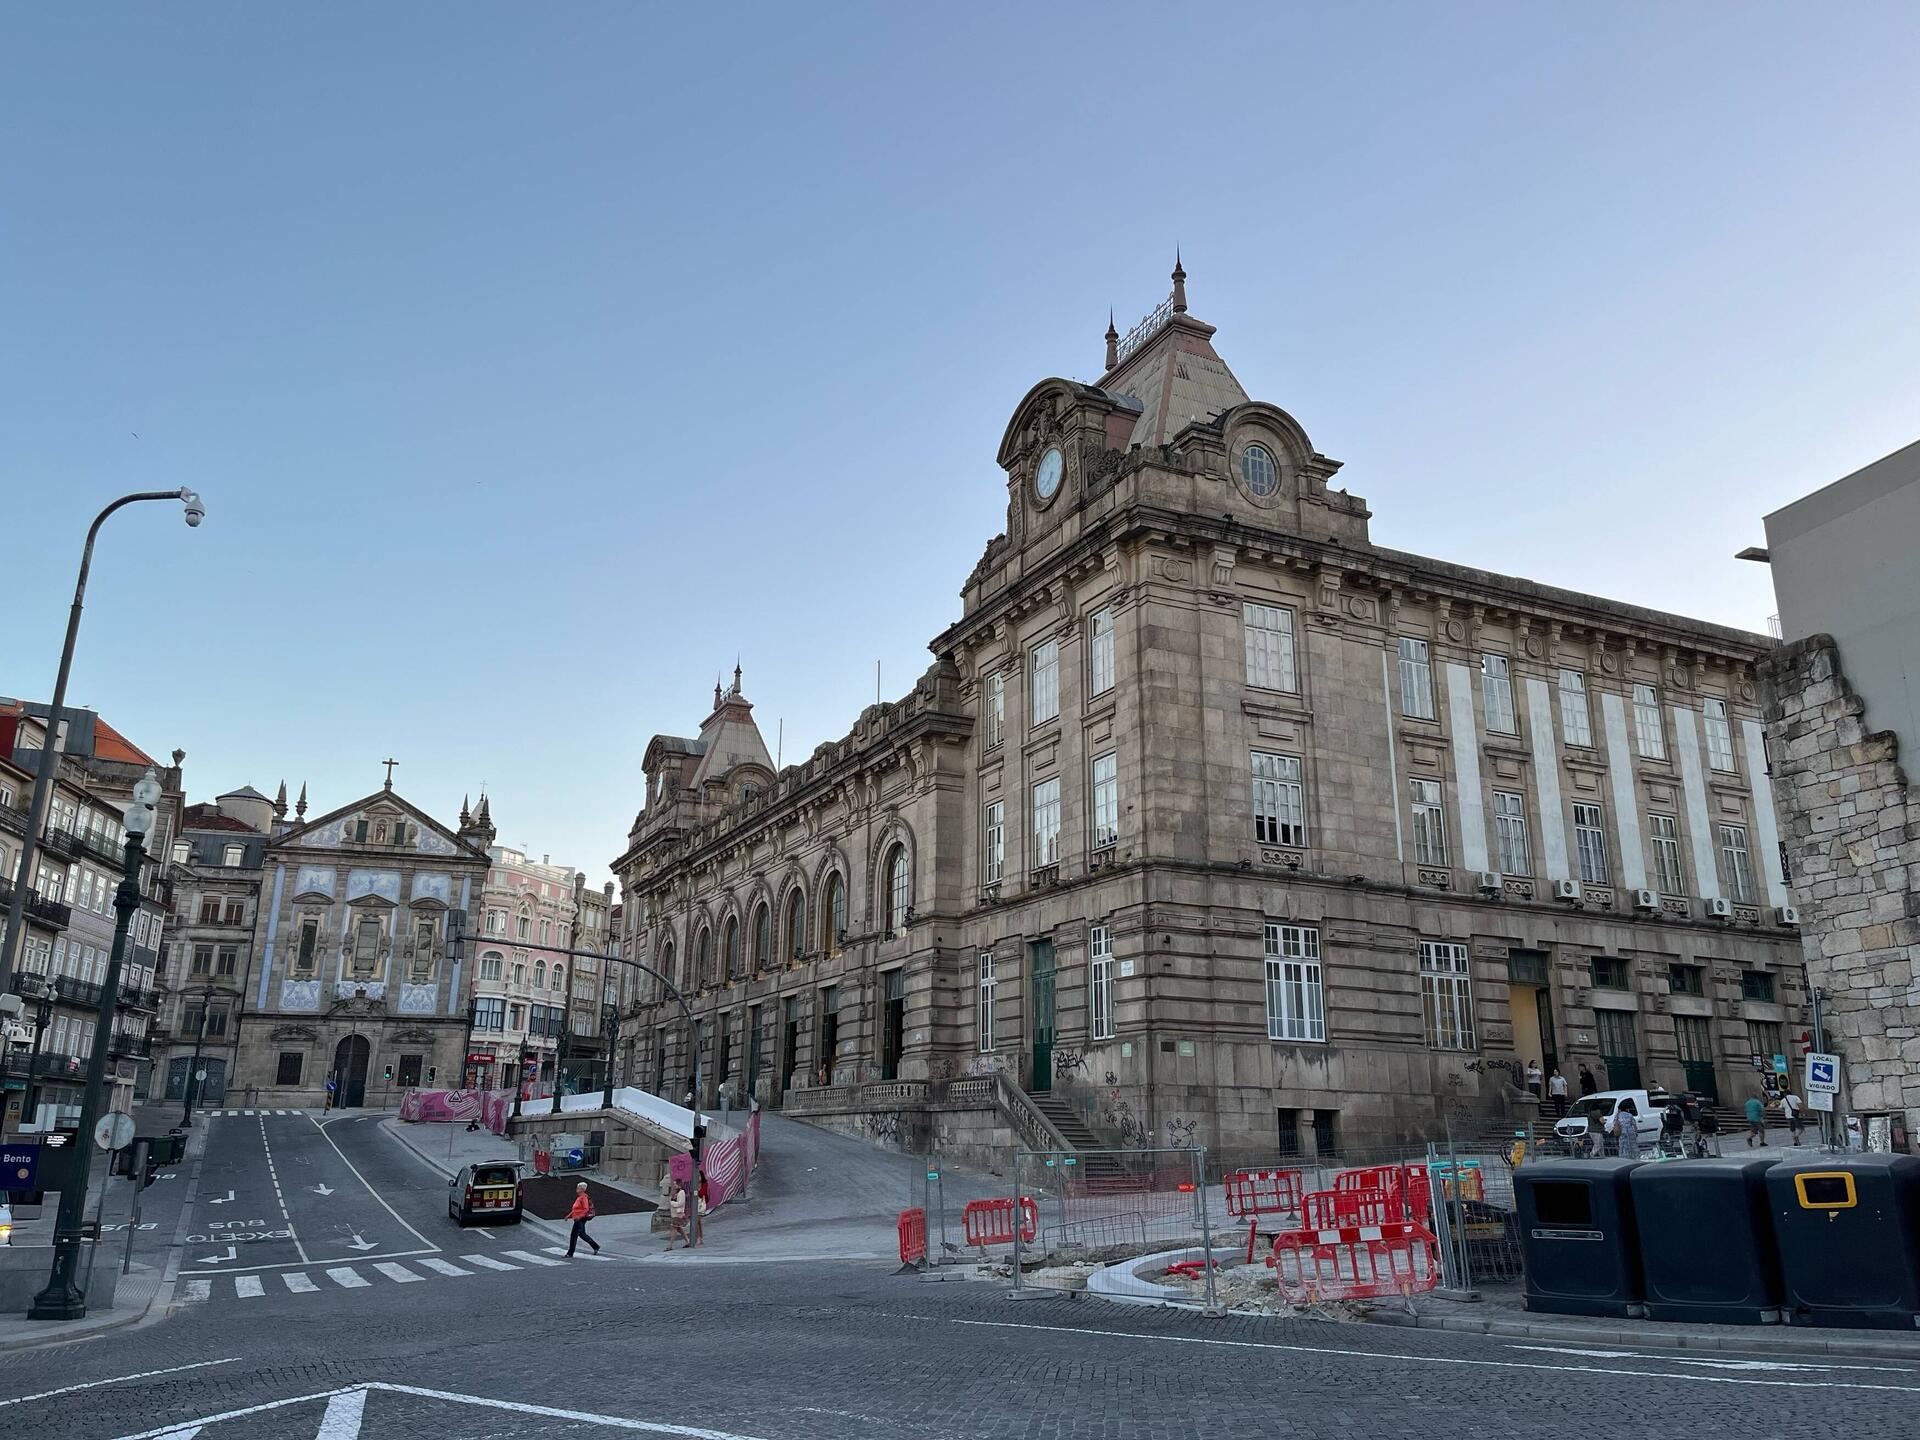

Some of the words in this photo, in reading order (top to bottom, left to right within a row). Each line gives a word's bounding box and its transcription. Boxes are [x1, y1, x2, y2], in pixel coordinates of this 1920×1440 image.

[1812, 1055, 1833, 1063] LOCAL
[1808, 1083, 1836, 1091] VIGIADO
[3, 1154, 31, 1163] Bento
[100, 1222, 159, 1232] BUS
[208, 1219, 266, 1229] BUS
[185, 1230, 292, 1243] EXCETO
